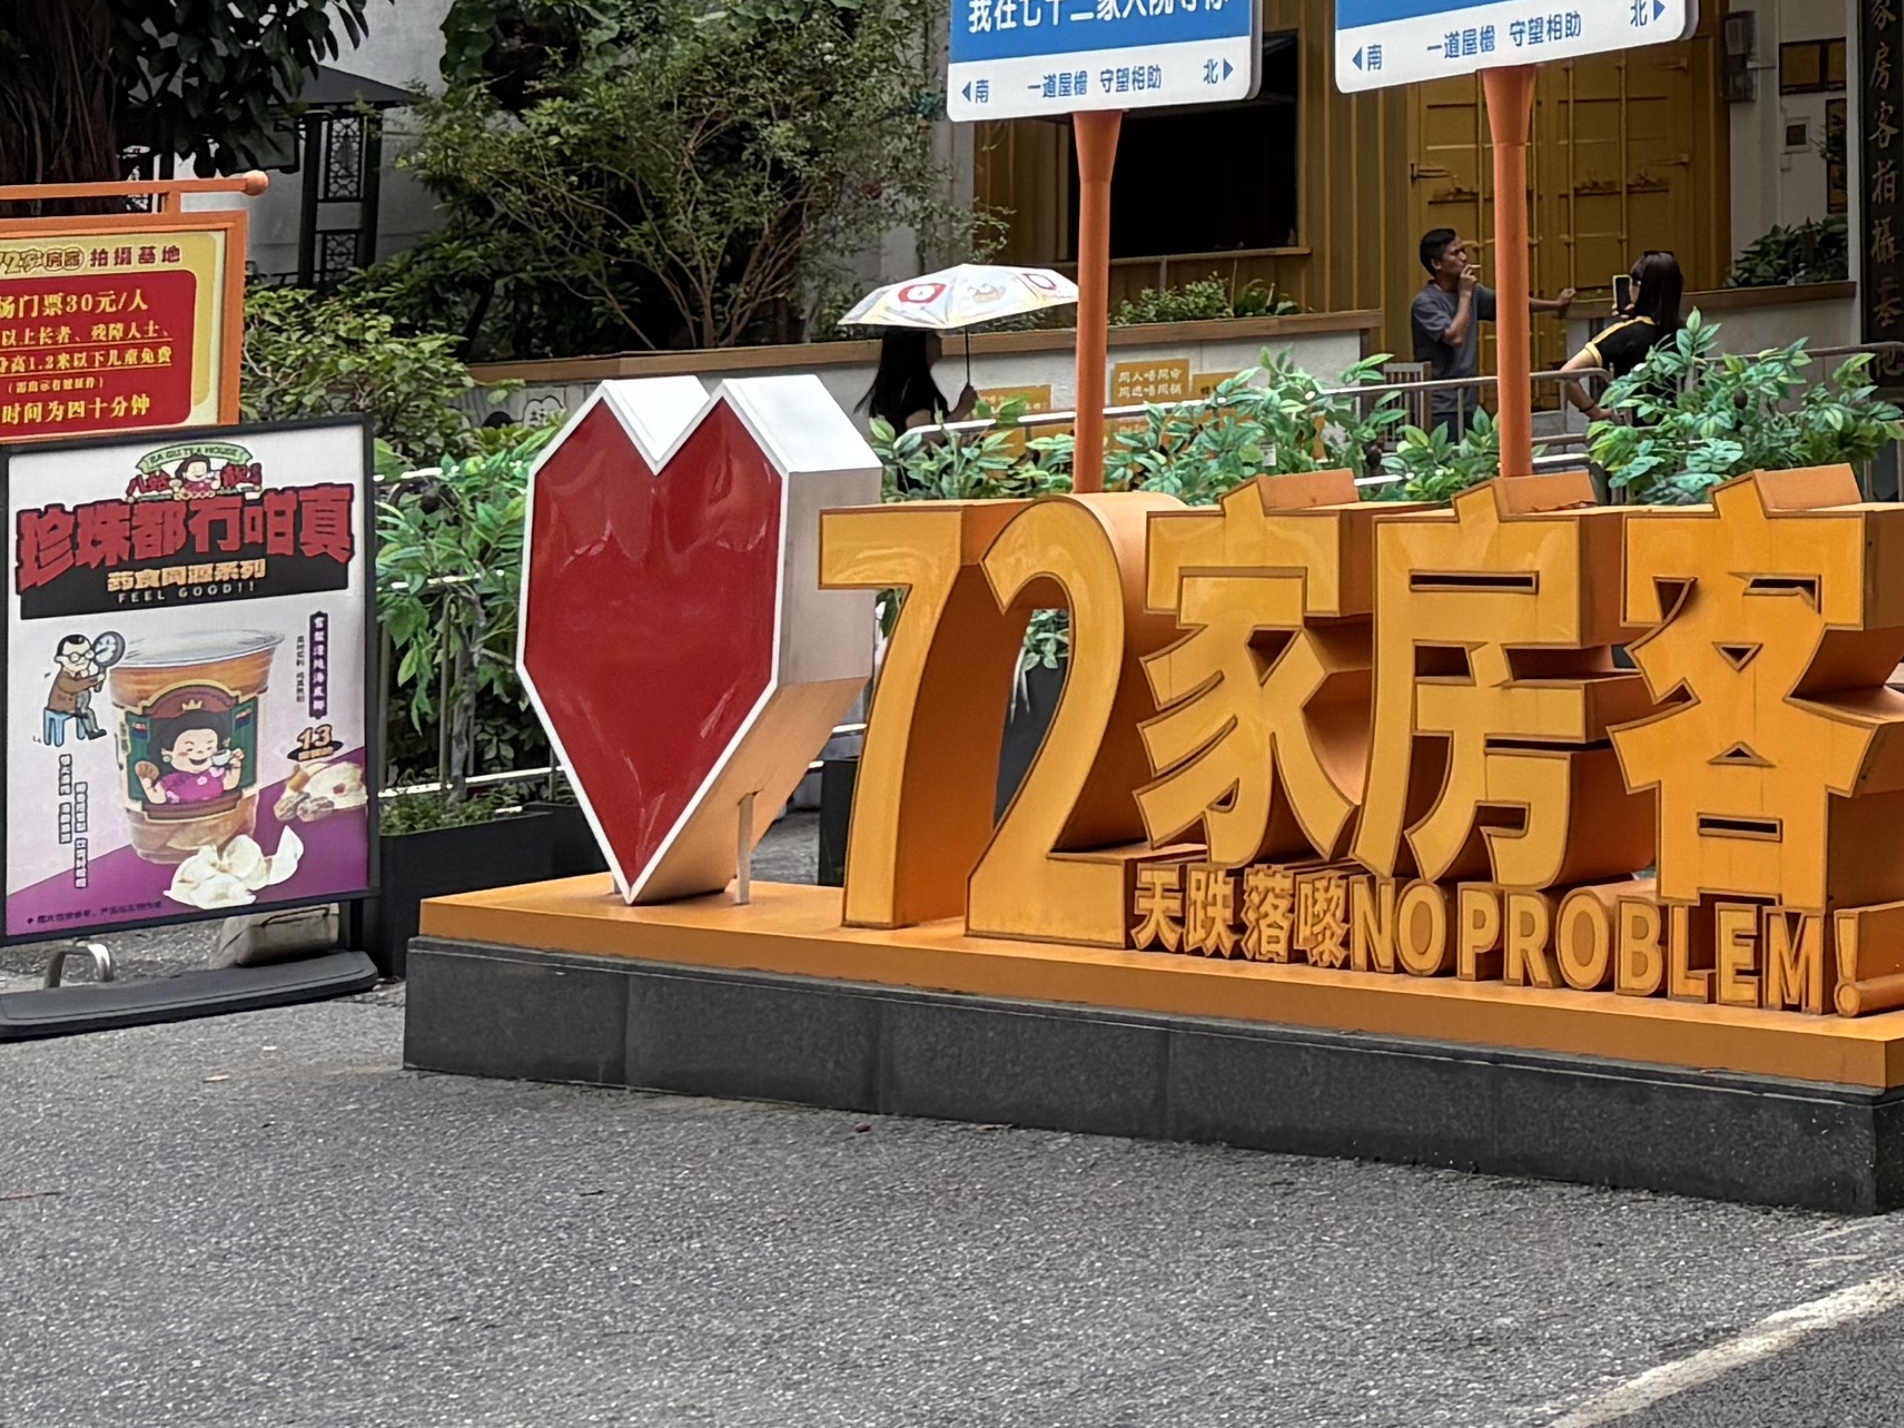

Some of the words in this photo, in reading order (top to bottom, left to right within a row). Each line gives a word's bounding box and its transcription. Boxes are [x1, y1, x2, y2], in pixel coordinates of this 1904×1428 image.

[1367, 44, 1383, 72] 南
[1509, 13, 1582, 46] 守望相助
[973, 80, 989, 104] 南
[1099, 65, 1163, 94] 守望相助
[1202, 58, 1219, 84] 北
[18, 485, 354, 592] 珍珠都冇咁真
[118, 589, 165, 604] FEEL
[179, 581, 256, 599] GOOD!!
[298, 724, 332, 749] 13
[819, 475, 1880, 947] 72家房客
[1134, 864, 1349, 971] 天跌落嚟
